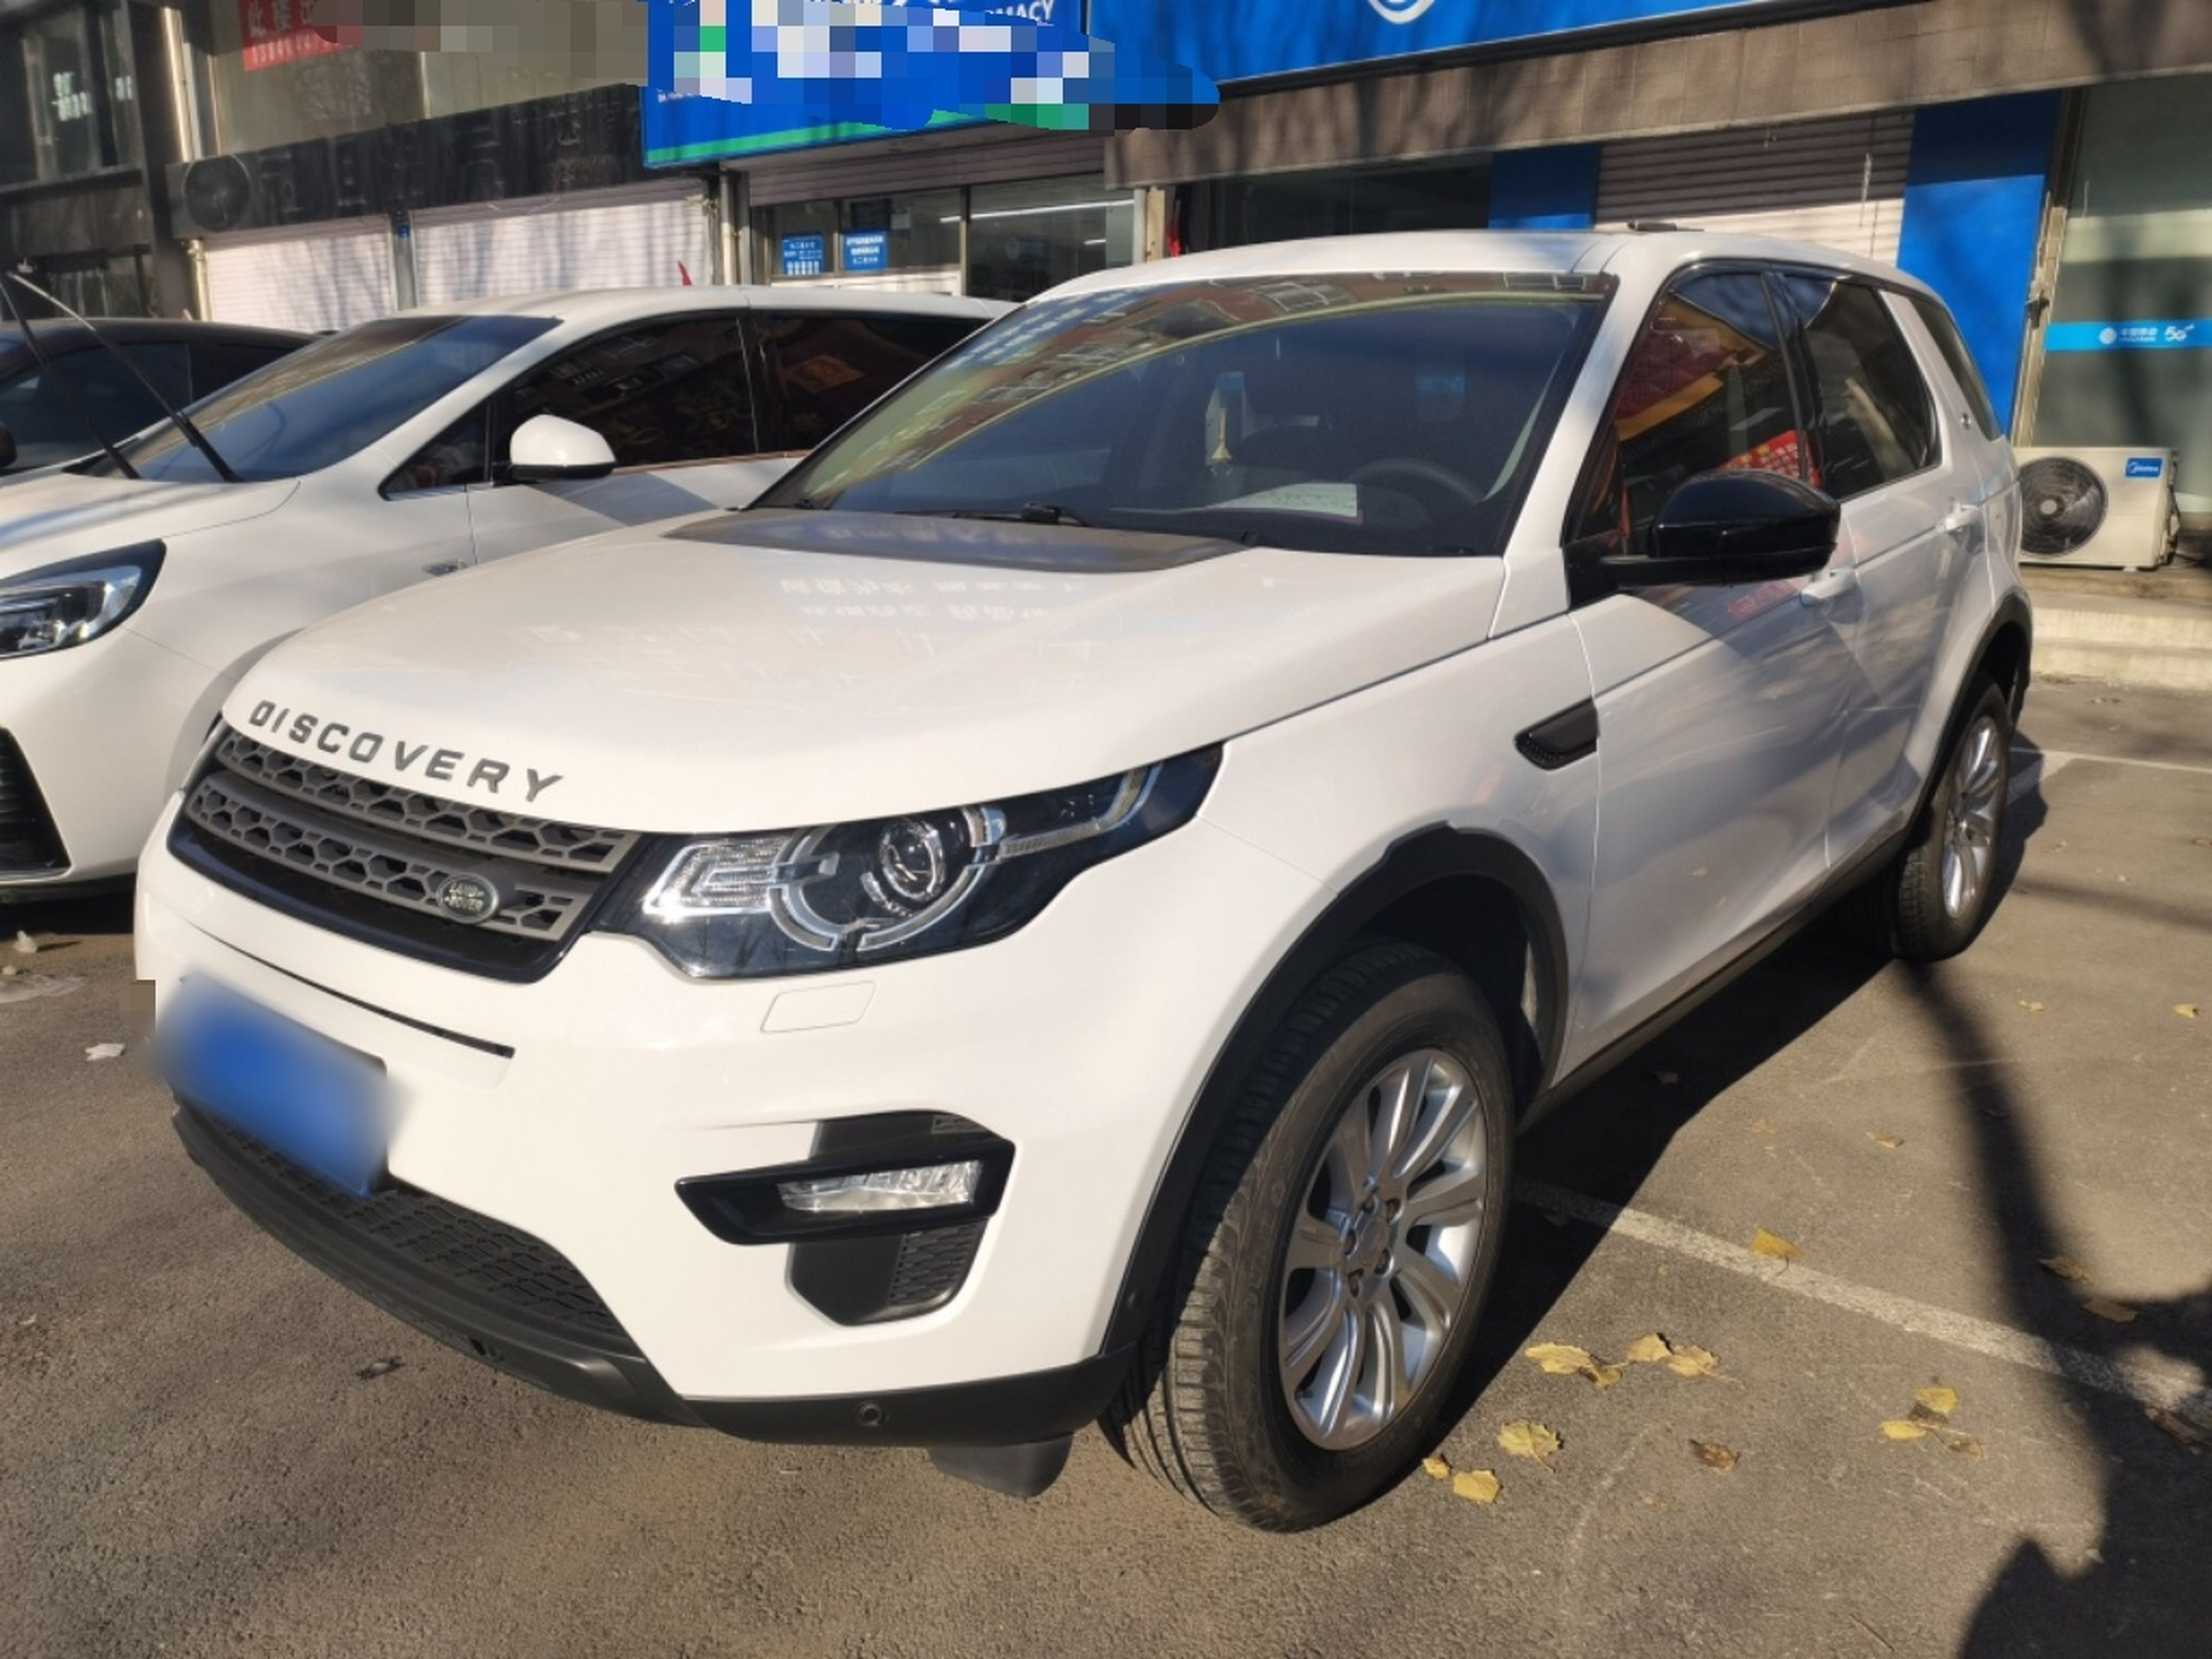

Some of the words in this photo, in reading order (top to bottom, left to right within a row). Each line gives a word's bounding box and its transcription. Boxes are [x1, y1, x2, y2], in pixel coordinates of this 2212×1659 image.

[249, 700, 564, 803] DISCOVERY
[449, 882, 478, 897] LAND
[449, 897, 484, 912] ROVER
